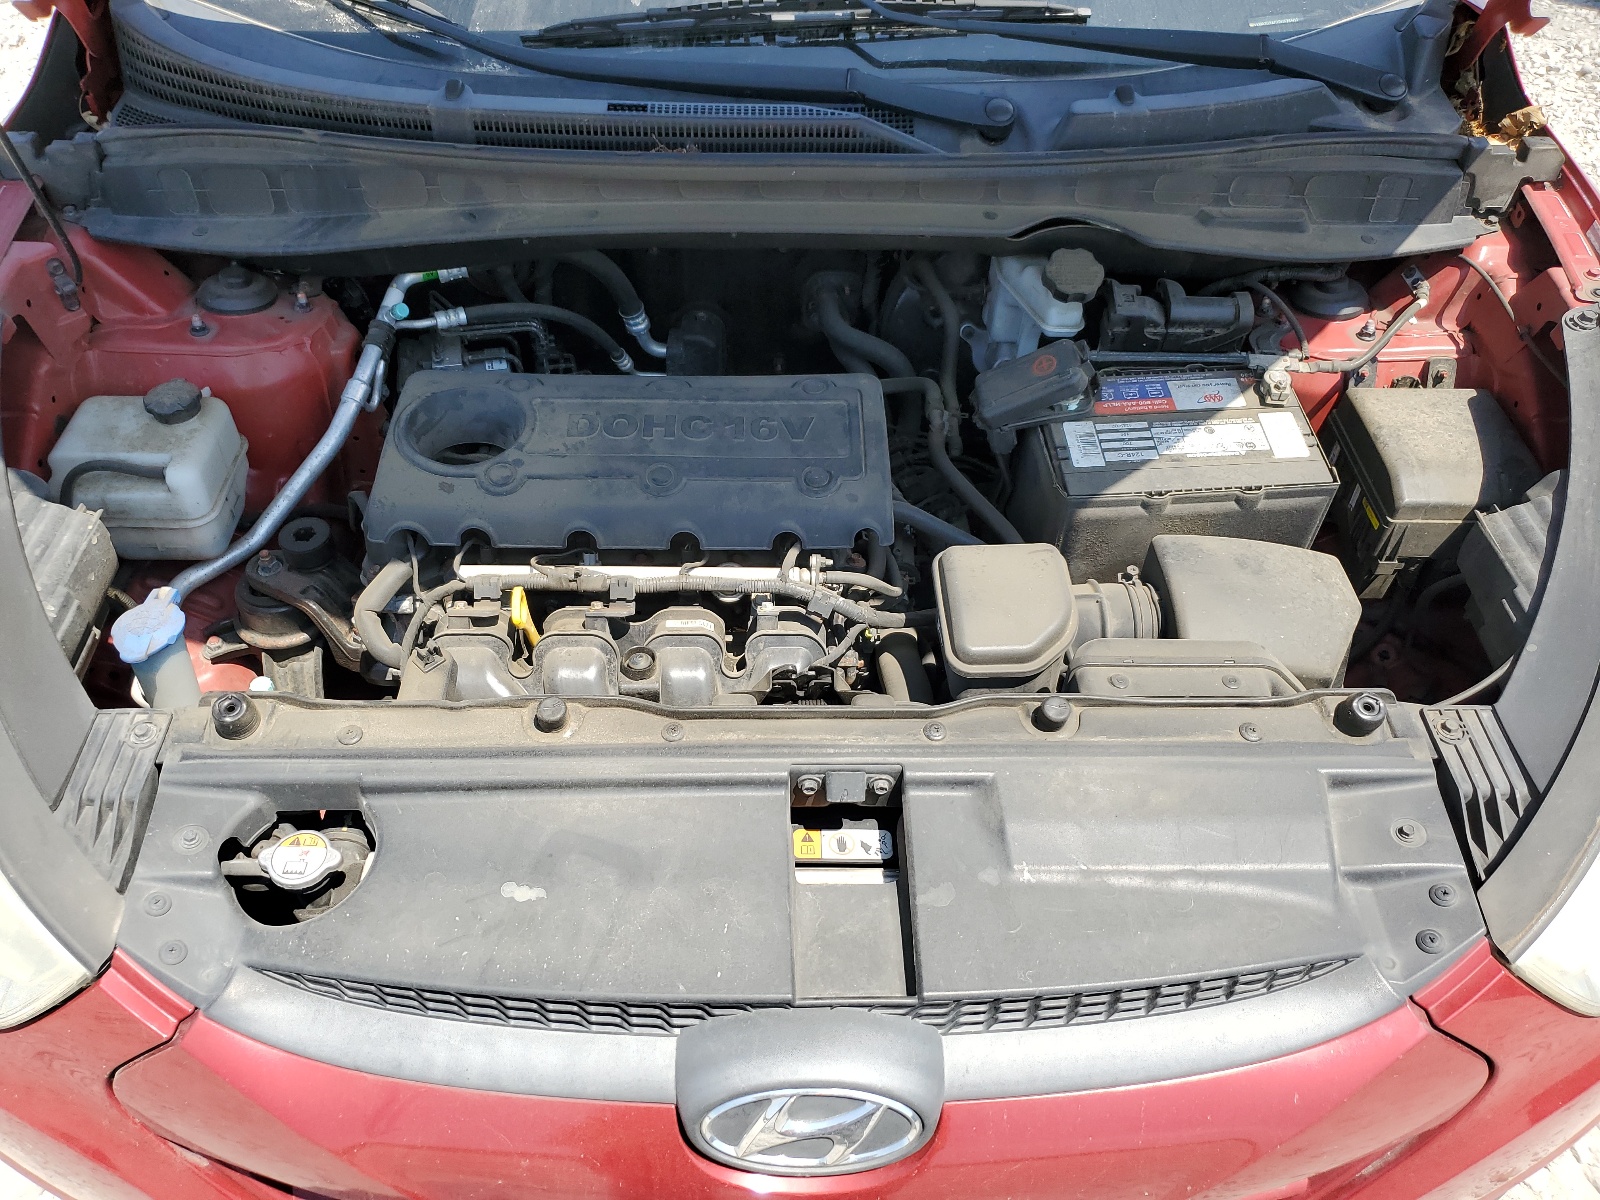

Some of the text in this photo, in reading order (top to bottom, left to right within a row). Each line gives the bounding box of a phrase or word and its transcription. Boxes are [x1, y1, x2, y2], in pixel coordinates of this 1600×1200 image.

[1204, 394, 1223, 402] AAA
[566, 413, 815, 442] DOHC 16V
